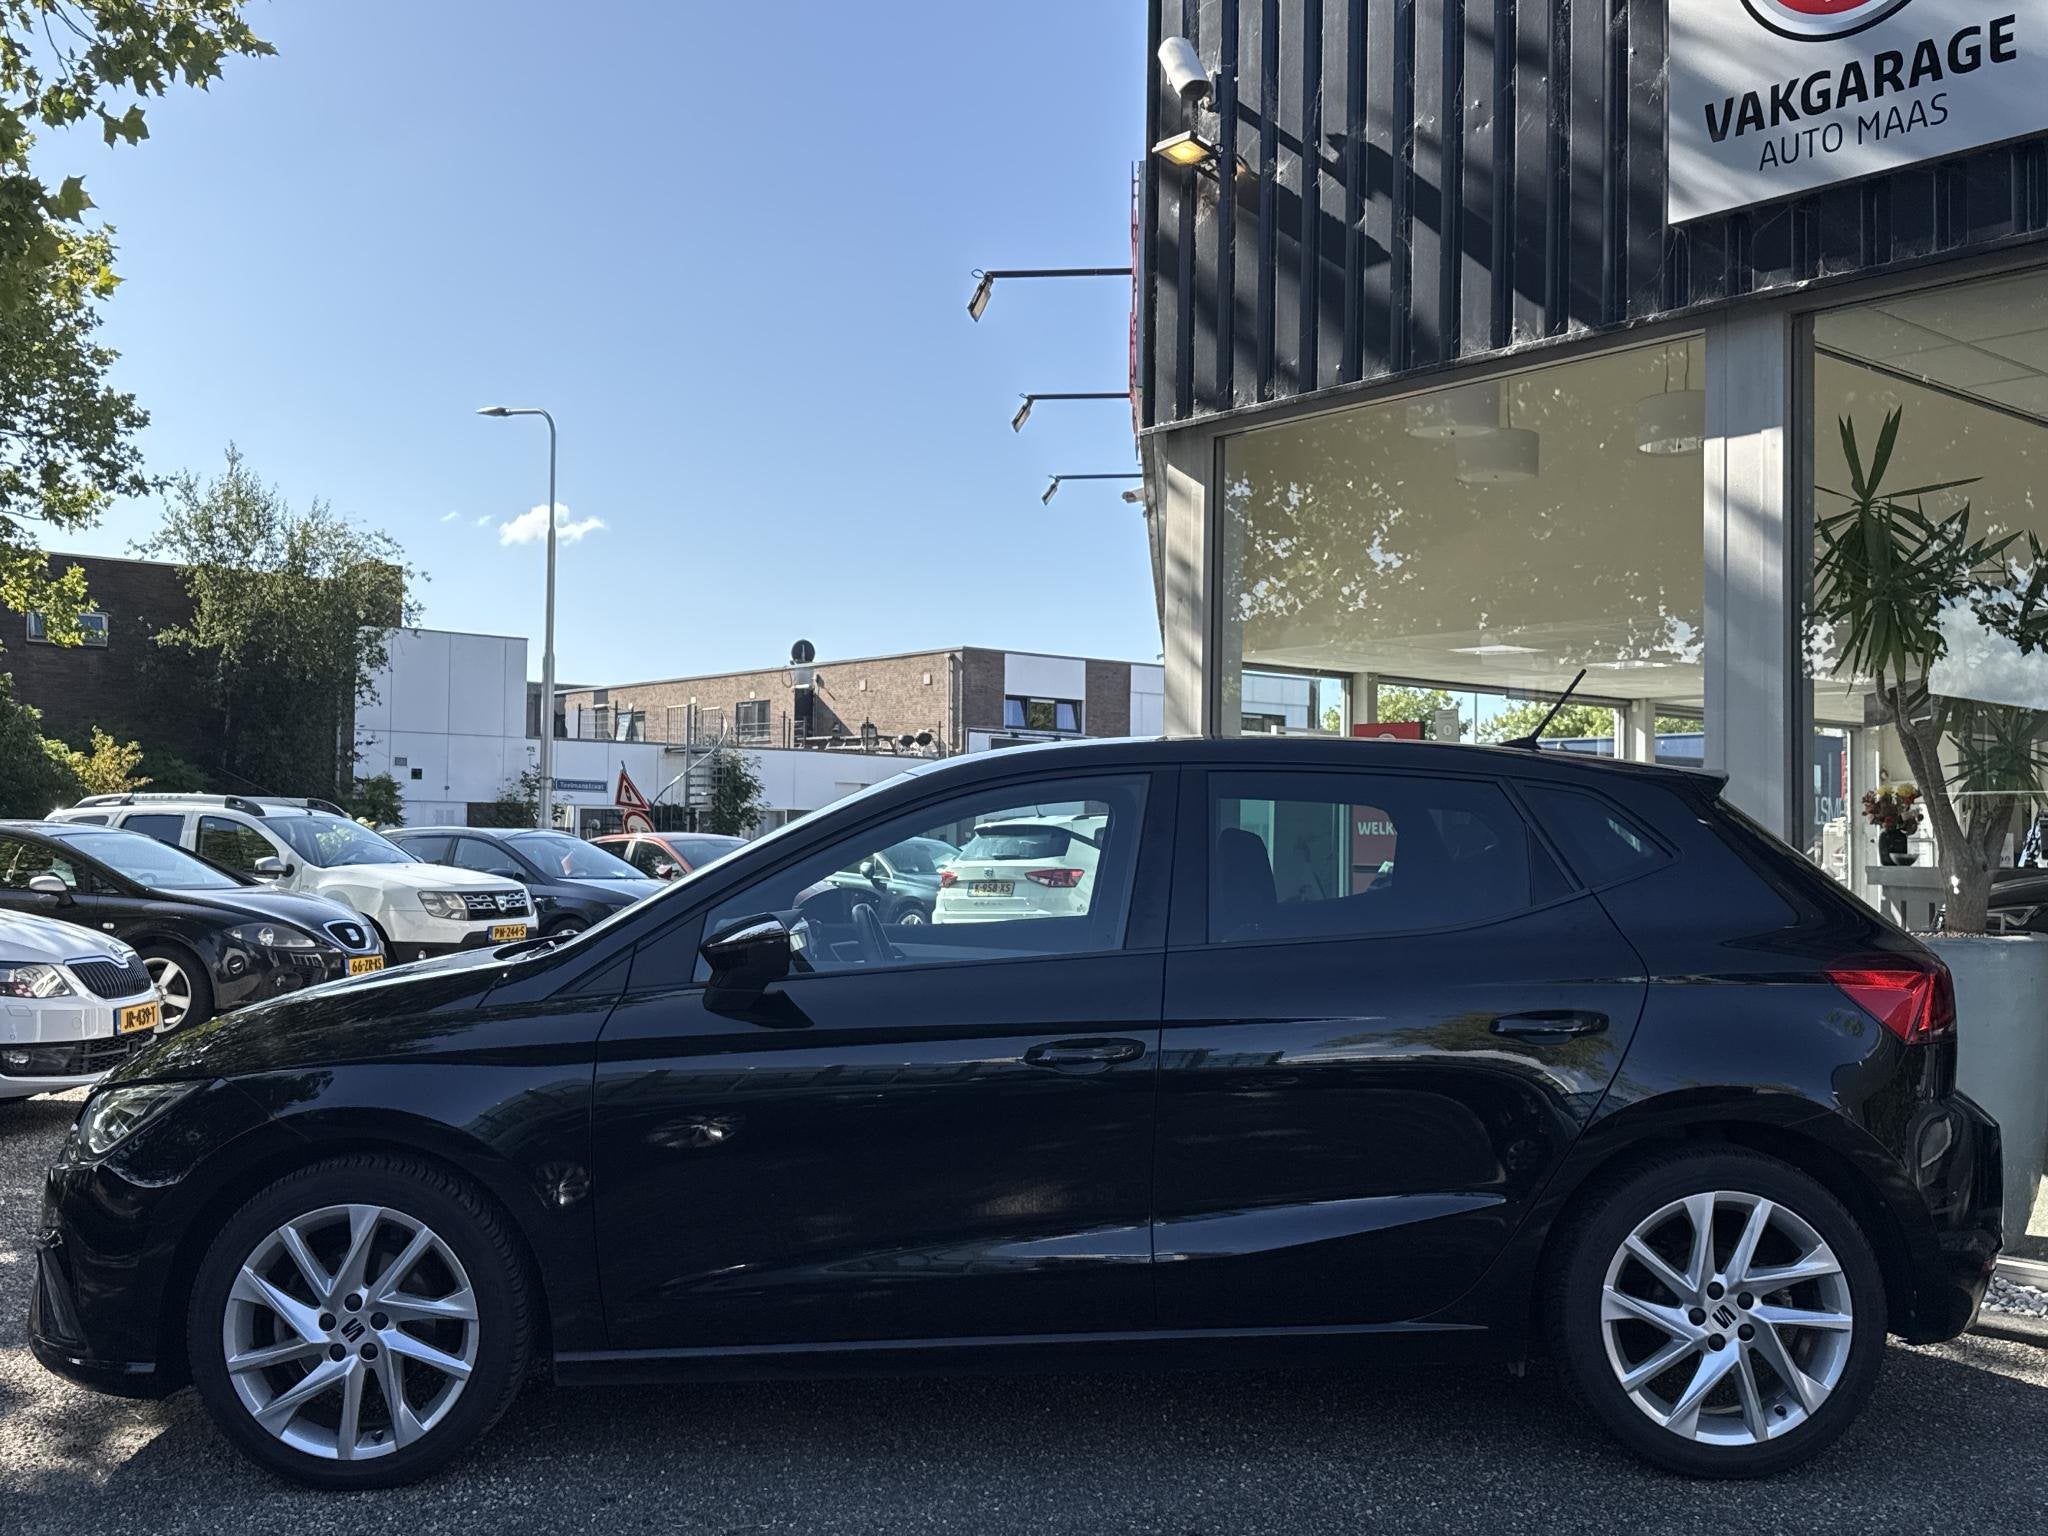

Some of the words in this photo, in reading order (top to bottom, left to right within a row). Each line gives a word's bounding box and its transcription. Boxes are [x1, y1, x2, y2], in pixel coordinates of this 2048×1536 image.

[1704, 14, 2017, 143] VAKGARAGE
[1758, 123, 1843, 171] AUTO
[1857, 93, 1949, 145] MAAS
[494, 926, 525, 938] PN-244-S
